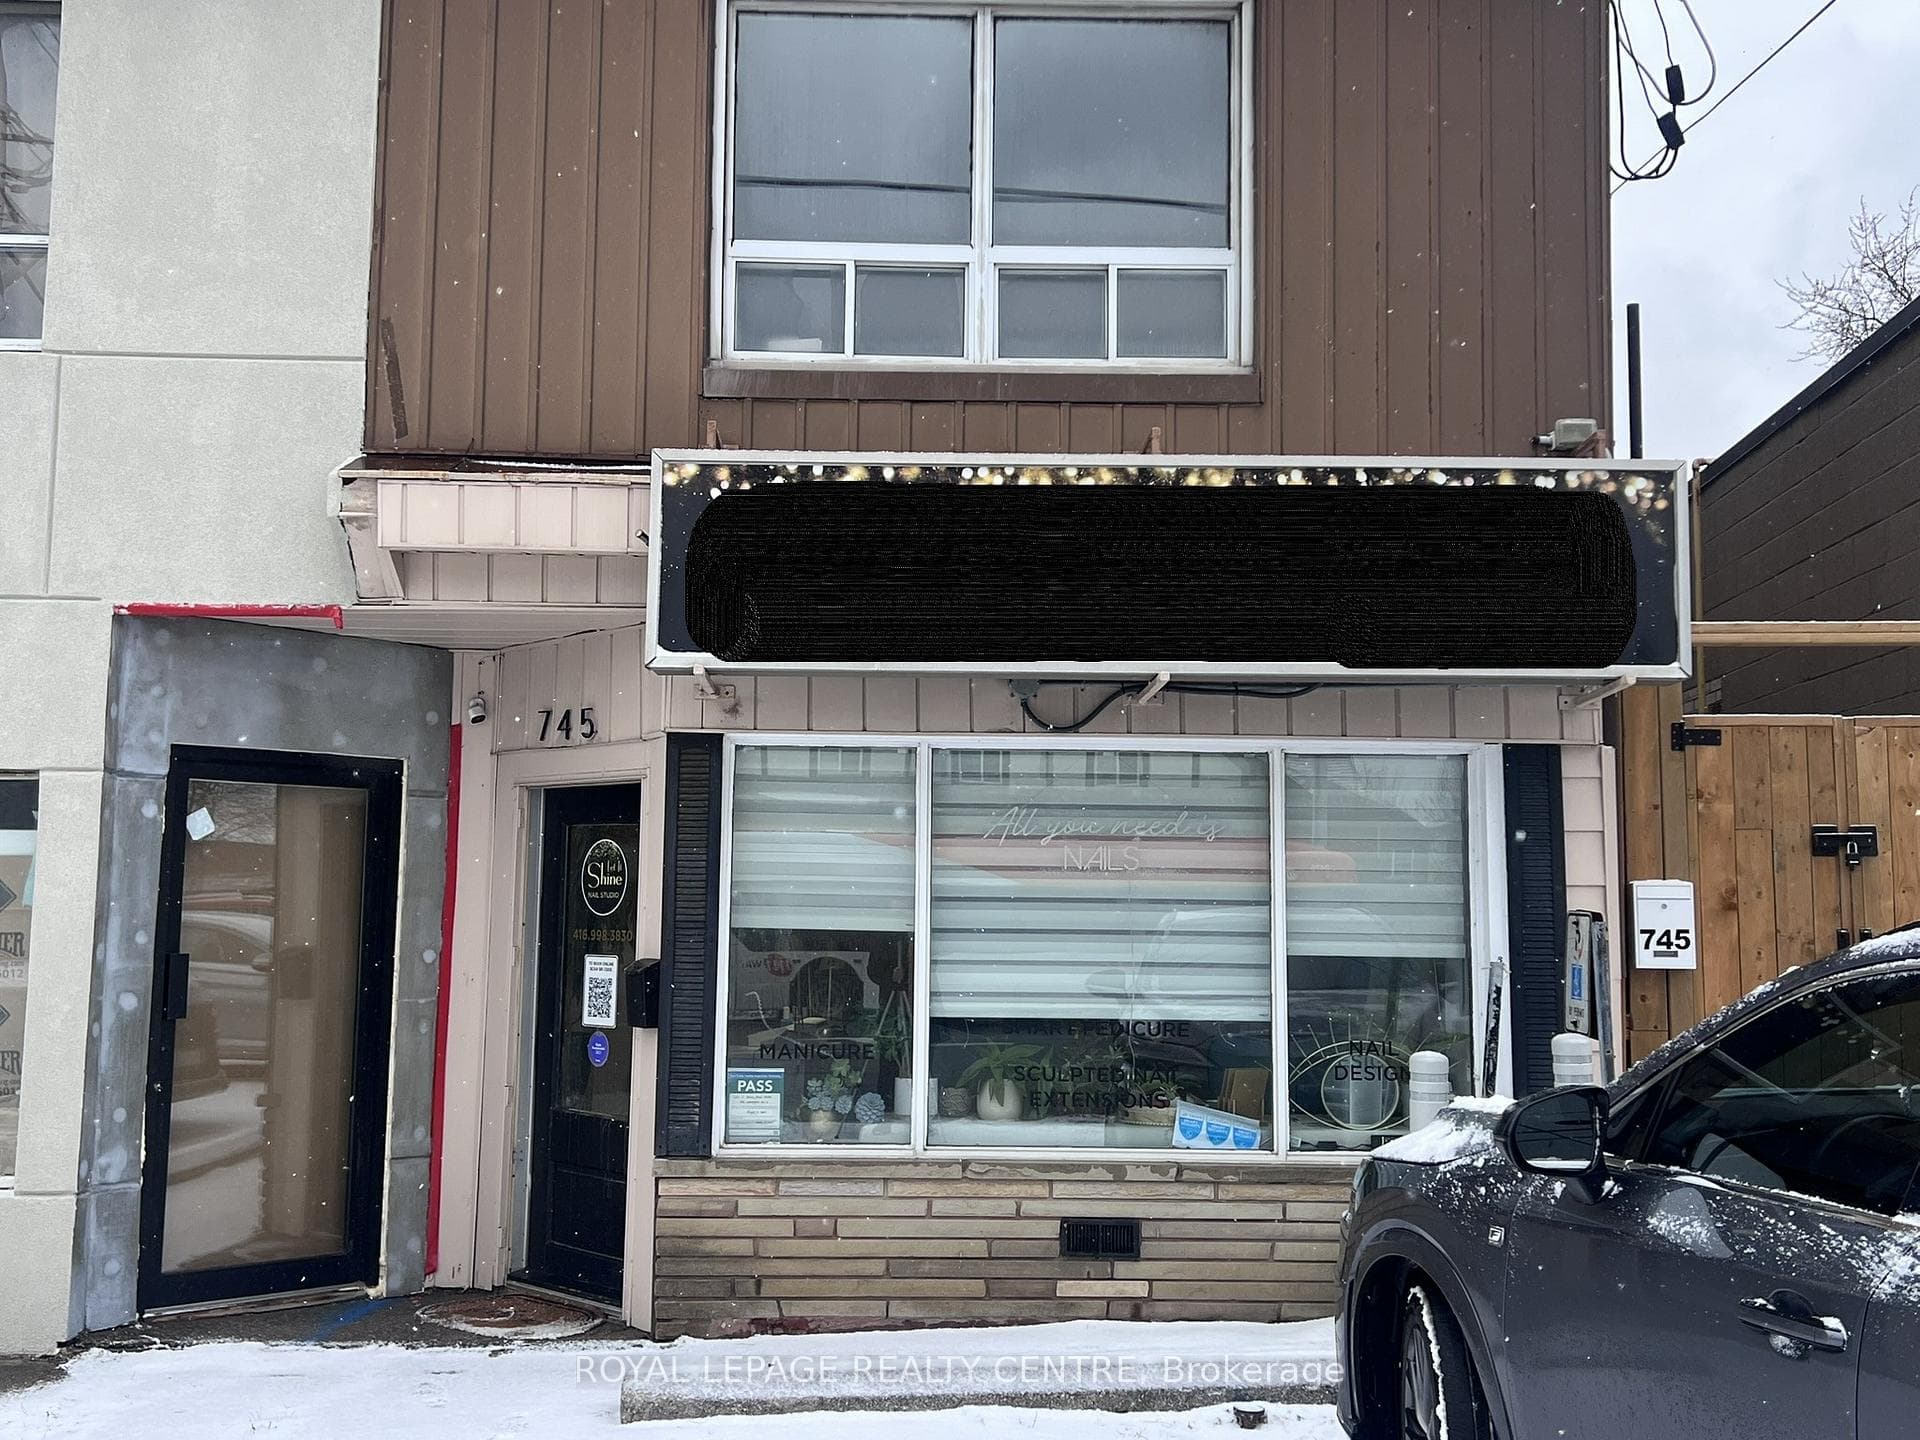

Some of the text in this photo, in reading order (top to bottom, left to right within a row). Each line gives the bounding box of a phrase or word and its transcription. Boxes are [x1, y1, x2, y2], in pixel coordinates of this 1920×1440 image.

[538, 707, 596, 742] 745
[982, 806, 1228, 847] All you need is
[1063, 844, 1140, 872] NAILS
[587, 861, 623, 889] Shine
[587, 891, 600, 899] NAIL
[0, 932, 24, 957] ER
[1640, 929, 1691, 950] 745
[0, 969, 23, 978] 012
[1083, 1021, 1190, 1038] PEDICURE
[760, 1043, 875, 1061] MANICURE
[1349, 1040, 1399, 1057] NAIL
[1014, 1066, 1125, 1083] SCULPTED
[1335, 1065, 1411, 1082] DESIGN
[737, 1079, 774, 1093] PASS
[1030, 1092, 1171, 1109] EXTENSIONS
